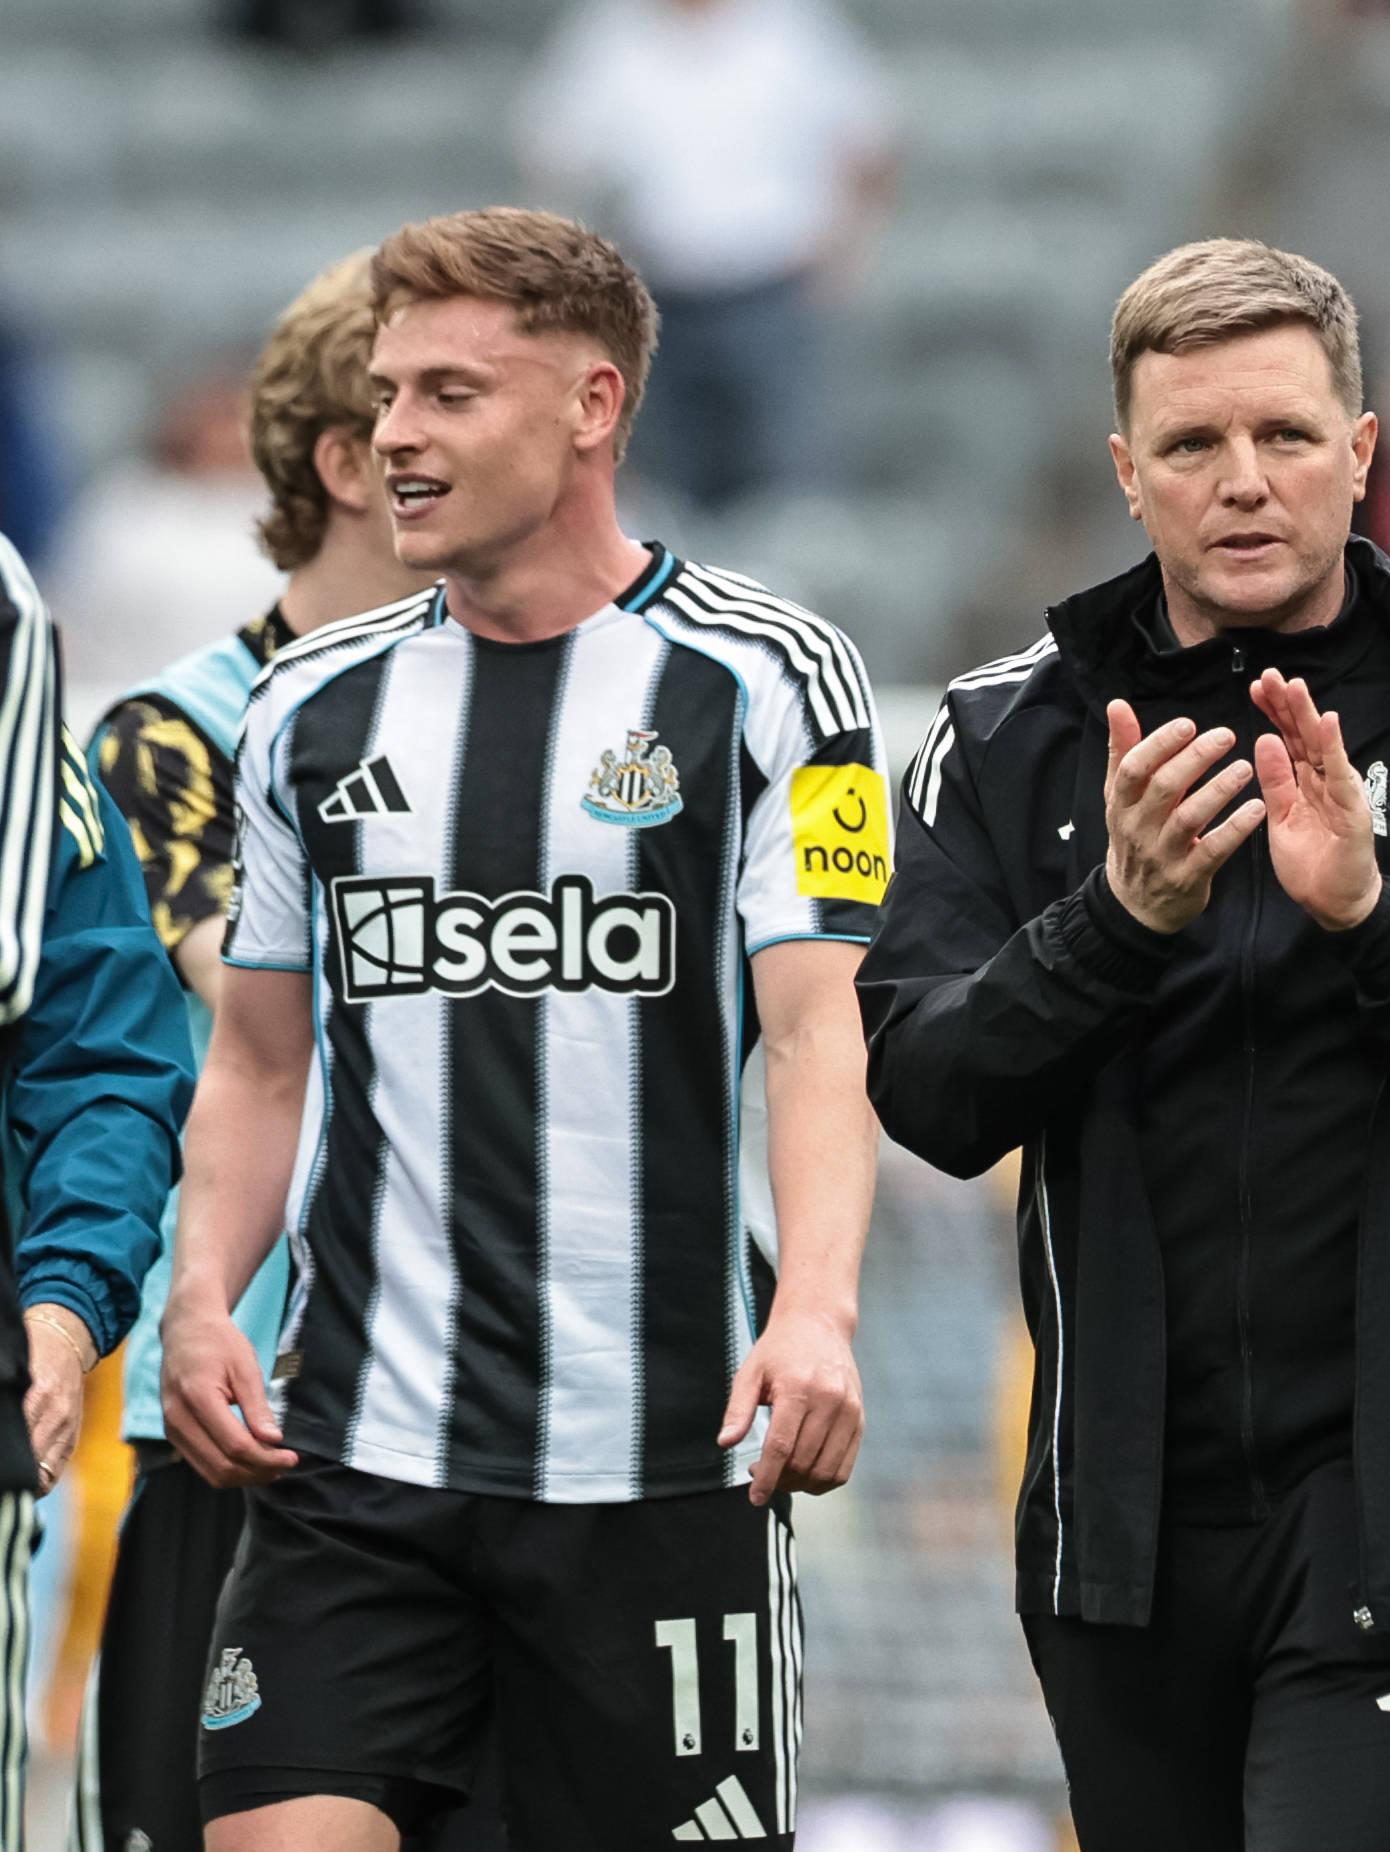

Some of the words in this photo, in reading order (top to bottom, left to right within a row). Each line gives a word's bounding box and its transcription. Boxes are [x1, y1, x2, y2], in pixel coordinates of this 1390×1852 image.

[804, 845, 887, 883] noon
[433, 886, 660, 982] sela
[655, 1612, 760, 1756] 11
